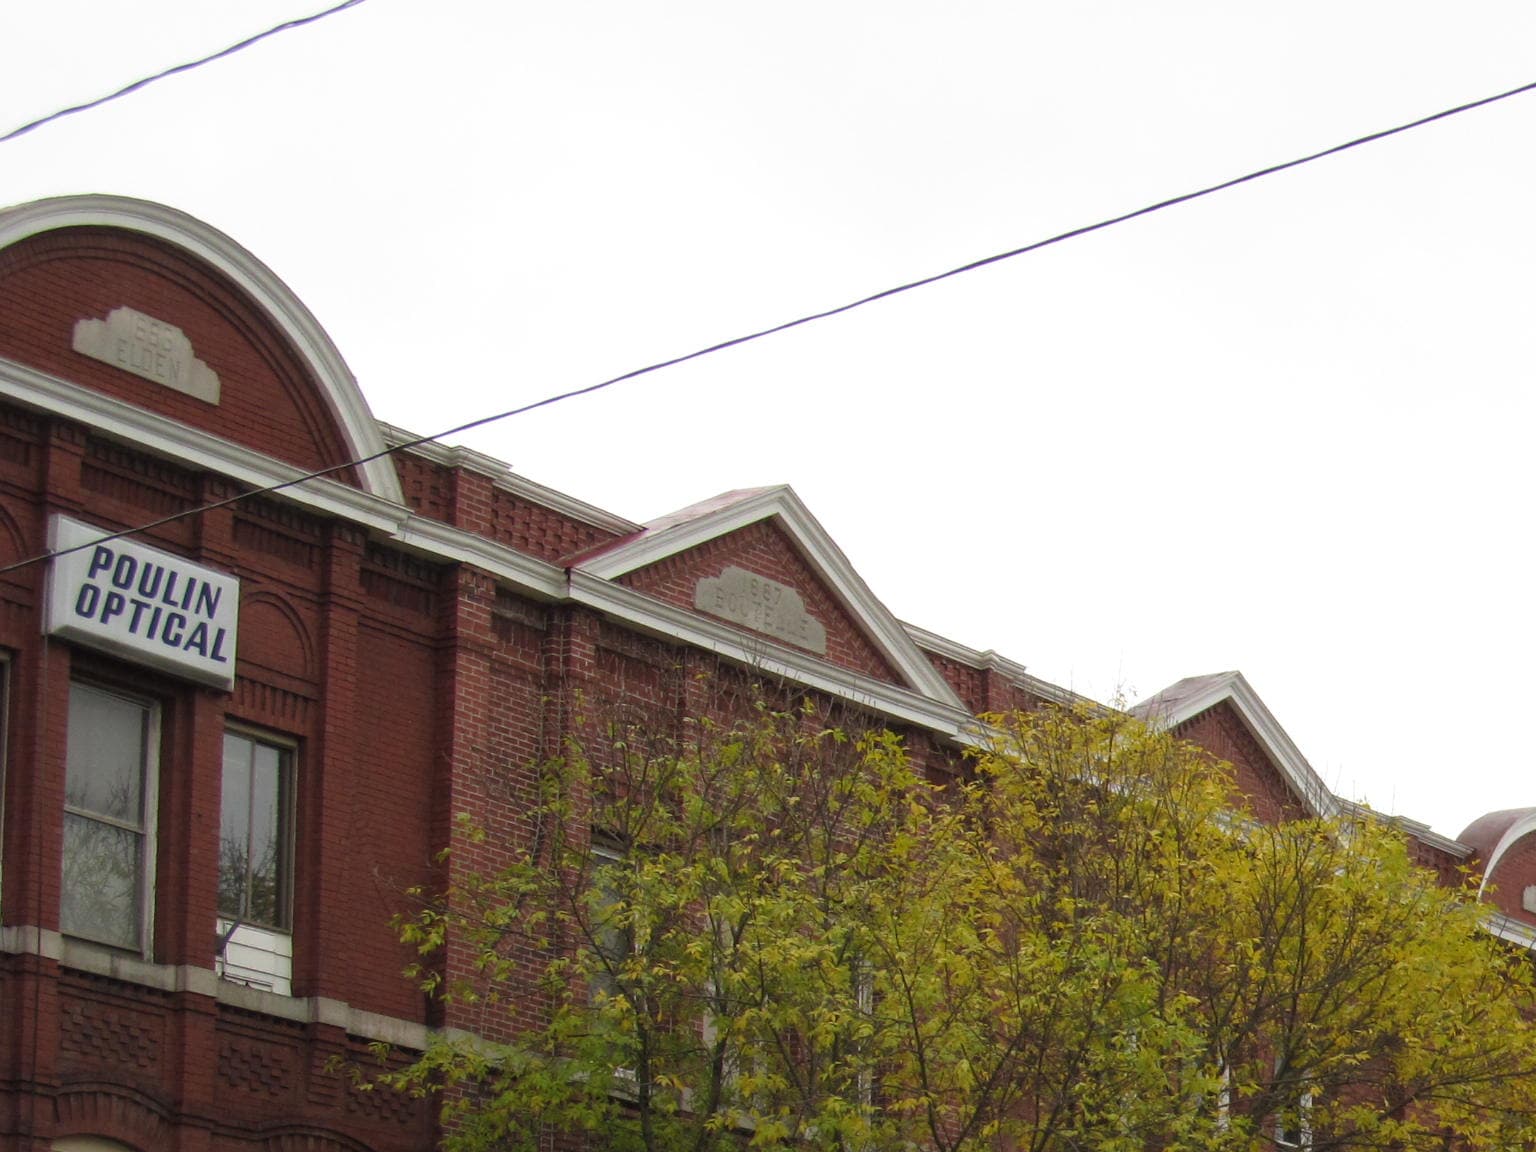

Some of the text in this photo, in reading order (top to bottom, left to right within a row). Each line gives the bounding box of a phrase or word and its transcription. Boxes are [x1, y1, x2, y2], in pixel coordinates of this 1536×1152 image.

[116, 337, 180, 382] ELDEN
[88, 545, 222, 619] POULIN
[75, 583, 227, 663] OPTICAL
